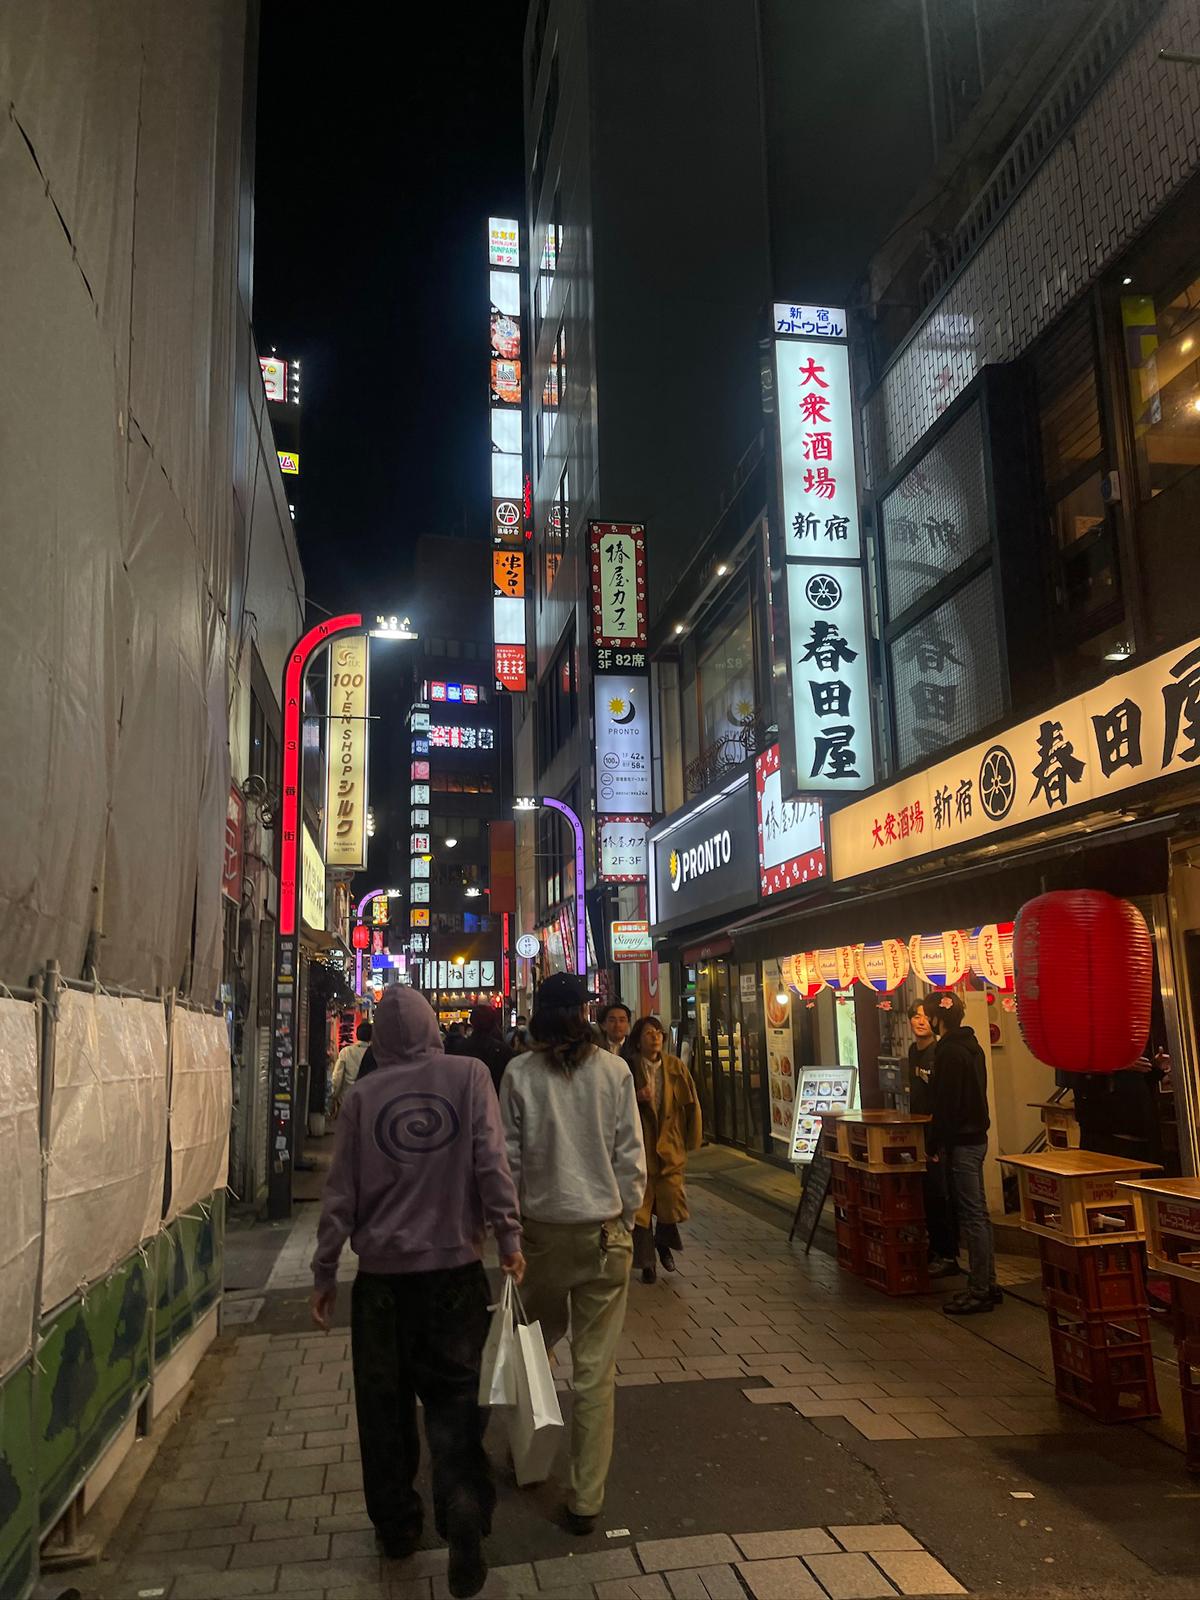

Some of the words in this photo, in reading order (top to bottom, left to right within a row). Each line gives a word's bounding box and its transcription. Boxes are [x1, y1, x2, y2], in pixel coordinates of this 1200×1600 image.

[491, 245, 518, 255] SUNPARK
[789, 306, 830, 322] 新宿
[777, 319, 844, 336] カトウビル
[798, 357, 837, 501] 大衆酒場
[791, 511, 851, 542] 新宿
[605, 540, 631, 631] 椿屋カフェ
[376, 615, 411, 625] MOA
[597, 649, 612, 659] 2F
[615, 653, 645, 668] 82席
[496, 659, 525, 674] 桂花
[597, 660, 613, 669] 3F
[333, 673, 363, 688] 100
[341, 690, 354, 725] YEN
[797, 620, 861, 779] 春田屋
[341, 729, 353, 776] SHOP
[336, 779, 355, 837] シルク
[933, 777, 973, 832] 新宿
[871, 799, 924, 849] 大衆酒場
[682, 829, 731, 883] PRONTO
[614, 934, 644, 949] Sunny
[866, 959, 884, 967] Asahi
[448, 967, 494, 982] ねぎし
